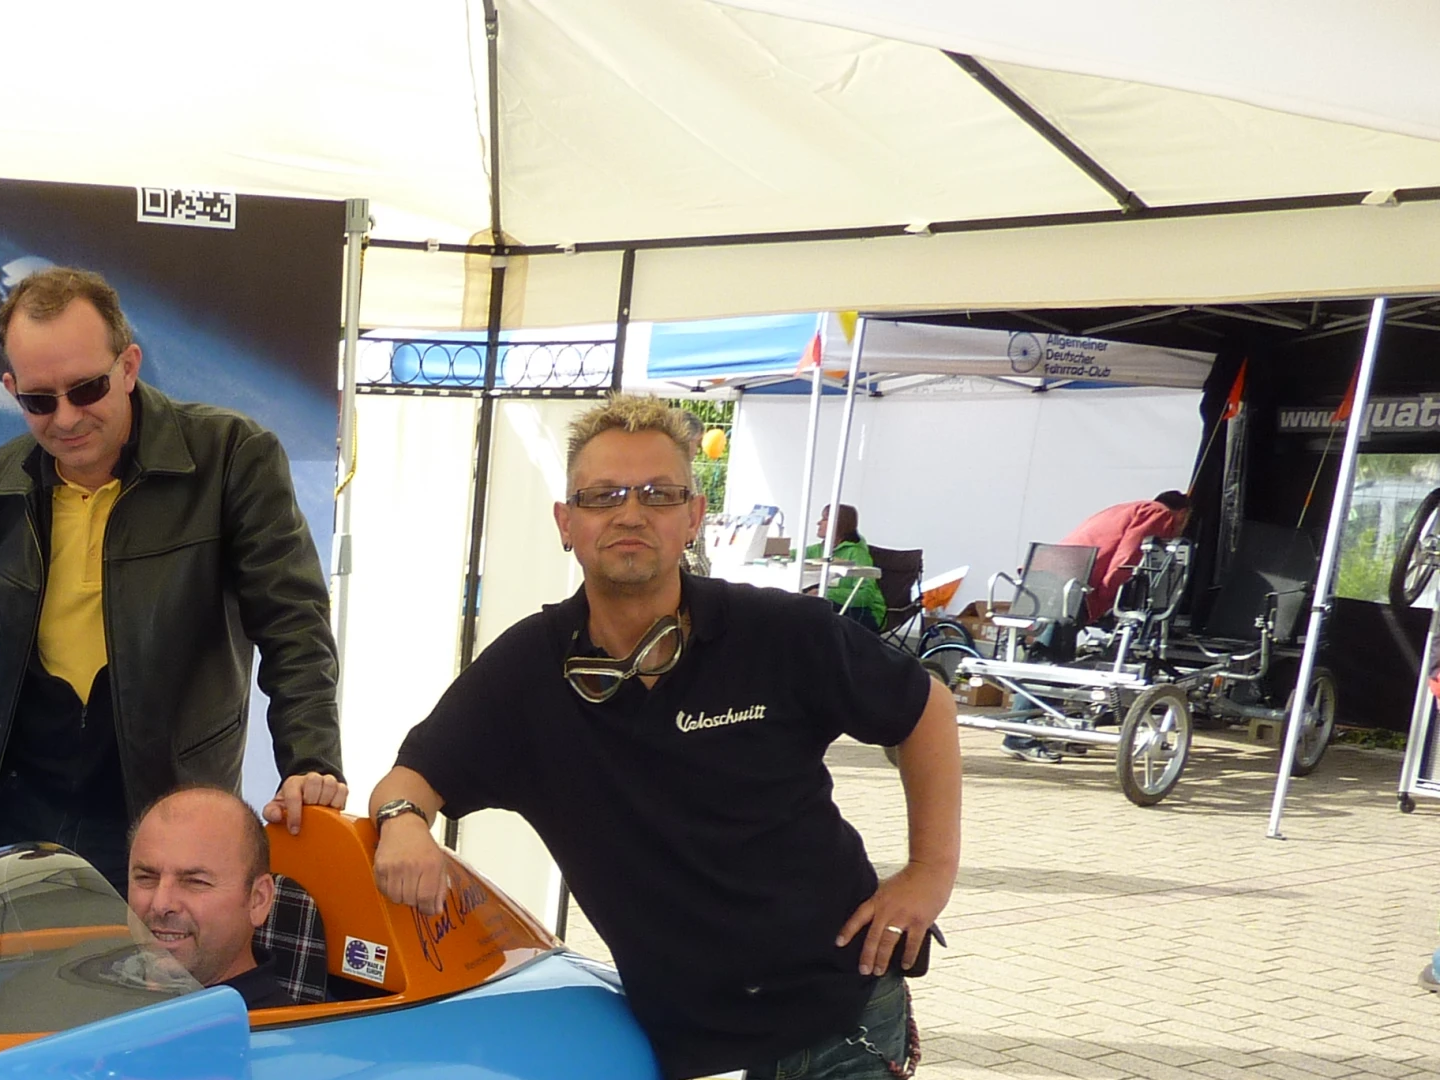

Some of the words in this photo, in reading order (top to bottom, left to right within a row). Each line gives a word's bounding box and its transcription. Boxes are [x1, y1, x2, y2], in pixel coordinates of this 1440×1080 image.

[1047, 333, 1109, 351] Allgemeiner
[1046, 348, 1096, 364] Deutscher
[1044, 363, 1112, 378] Fahrrad-Club
